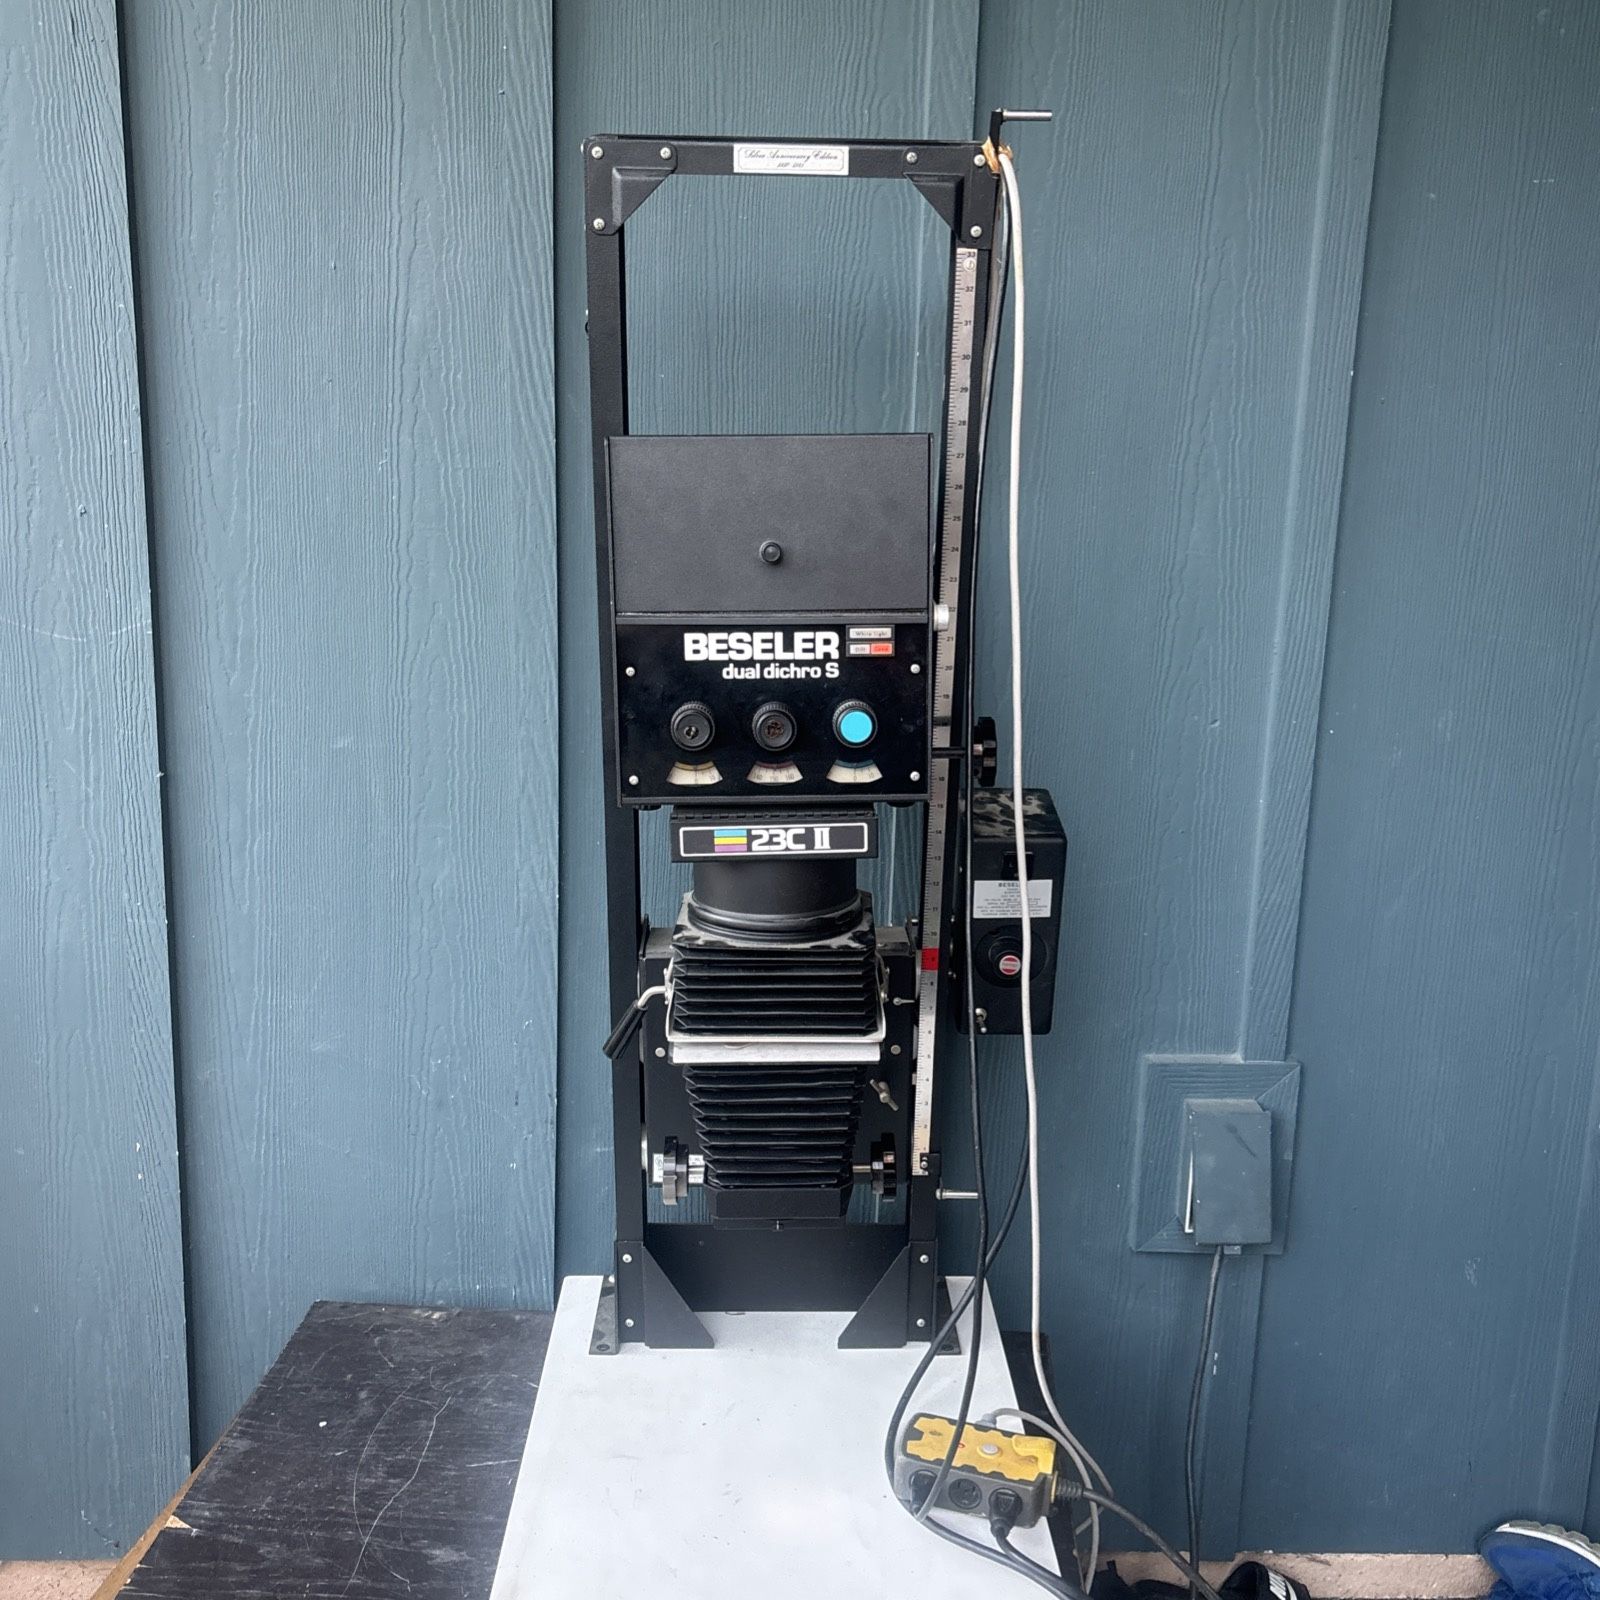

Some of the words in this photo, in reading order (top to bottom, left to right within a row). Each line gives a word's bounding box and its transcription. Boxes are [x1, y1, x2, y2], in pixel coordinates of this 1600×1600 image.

[811, 150, 838, 161] Edition
[683, 631, 840, 661] BESELER
[722, 663, 760, 679] dual
[763, 662, 822, 679] dichro
[825, 662, 840, 678] S
[751, 827, 806, 852] 23C
[813, 827, 831, 850] II
[1266, 1568, 1287, 1600] NIK
